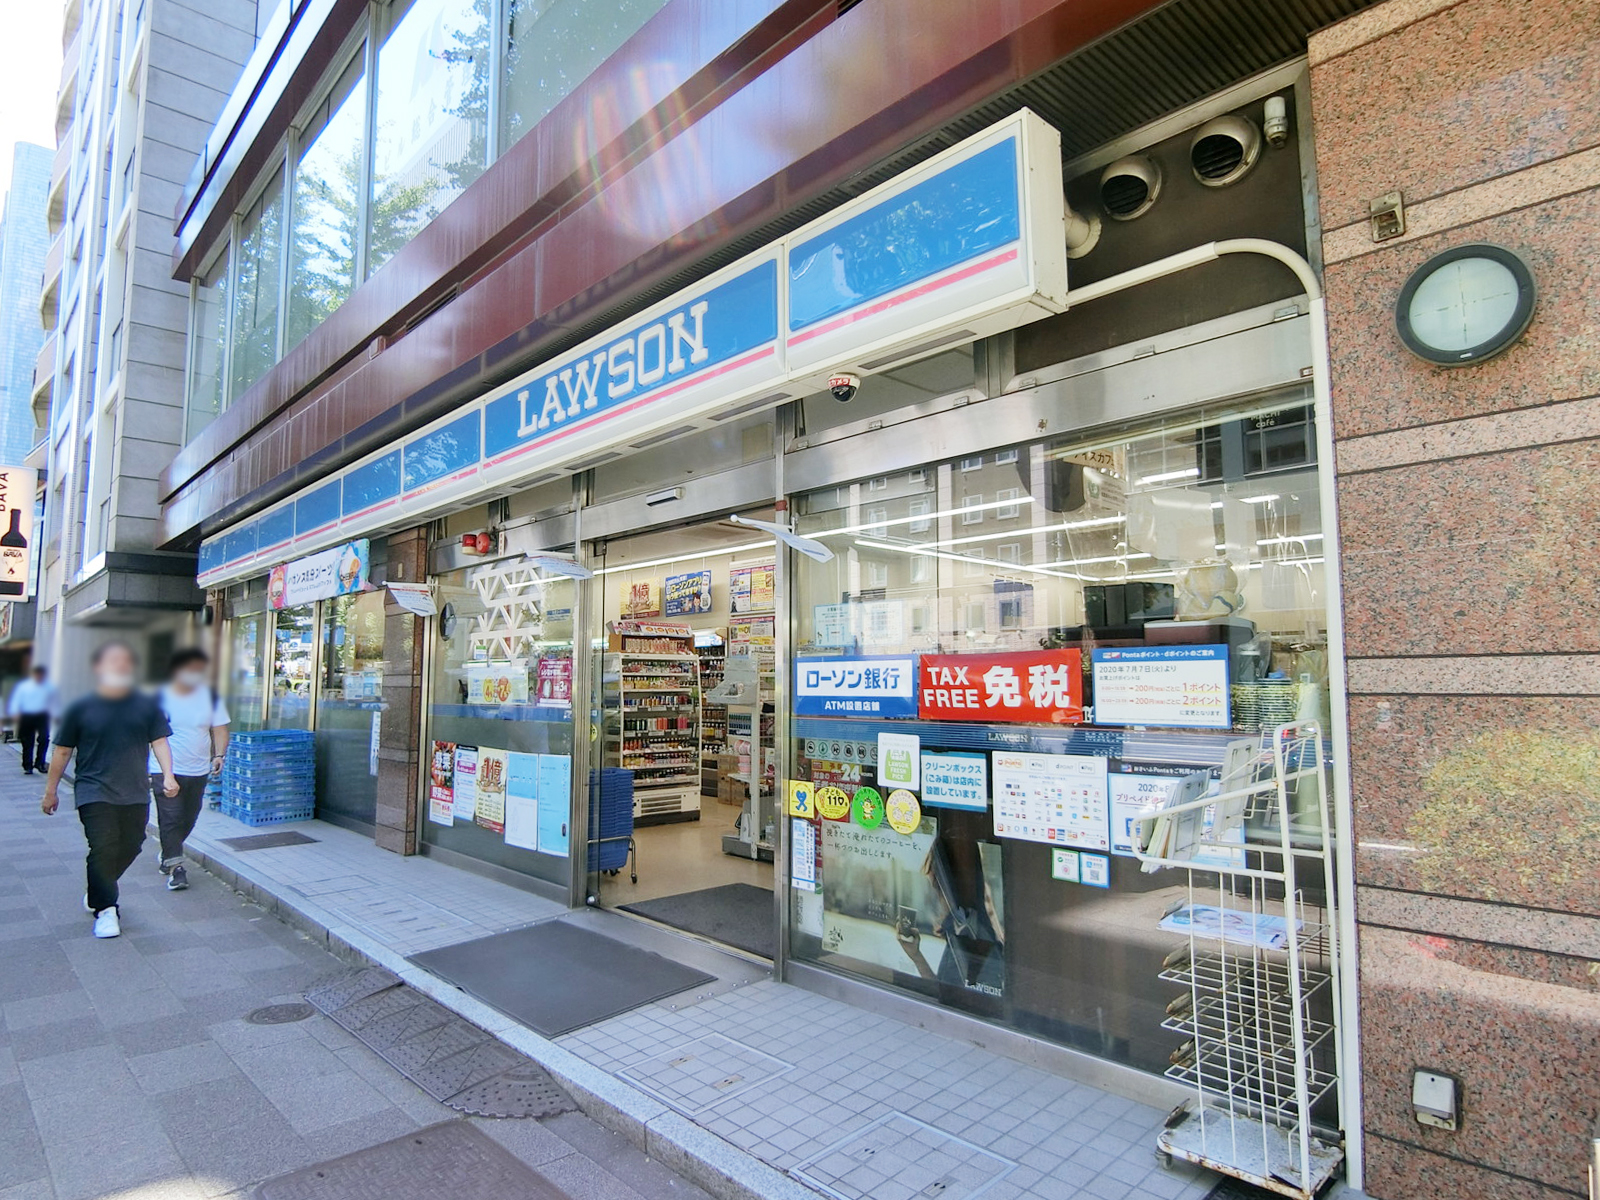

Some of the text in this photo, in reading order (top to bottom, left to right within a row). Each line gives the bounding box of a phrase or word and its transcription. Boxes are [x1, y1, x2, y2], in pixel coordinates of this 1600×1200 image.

[517, 300, 709, 438] LAWSON
[806, 667, 900, 689] ローソン銀行
[927, 666, 969, 685] TAX
[982, 663, 1069, 708] 免税
[824, 700, 881, 712] ATM設置店舗
[923, 688, 980, 708] FREE
[925, 762, 982, 774] クリーンボックス
